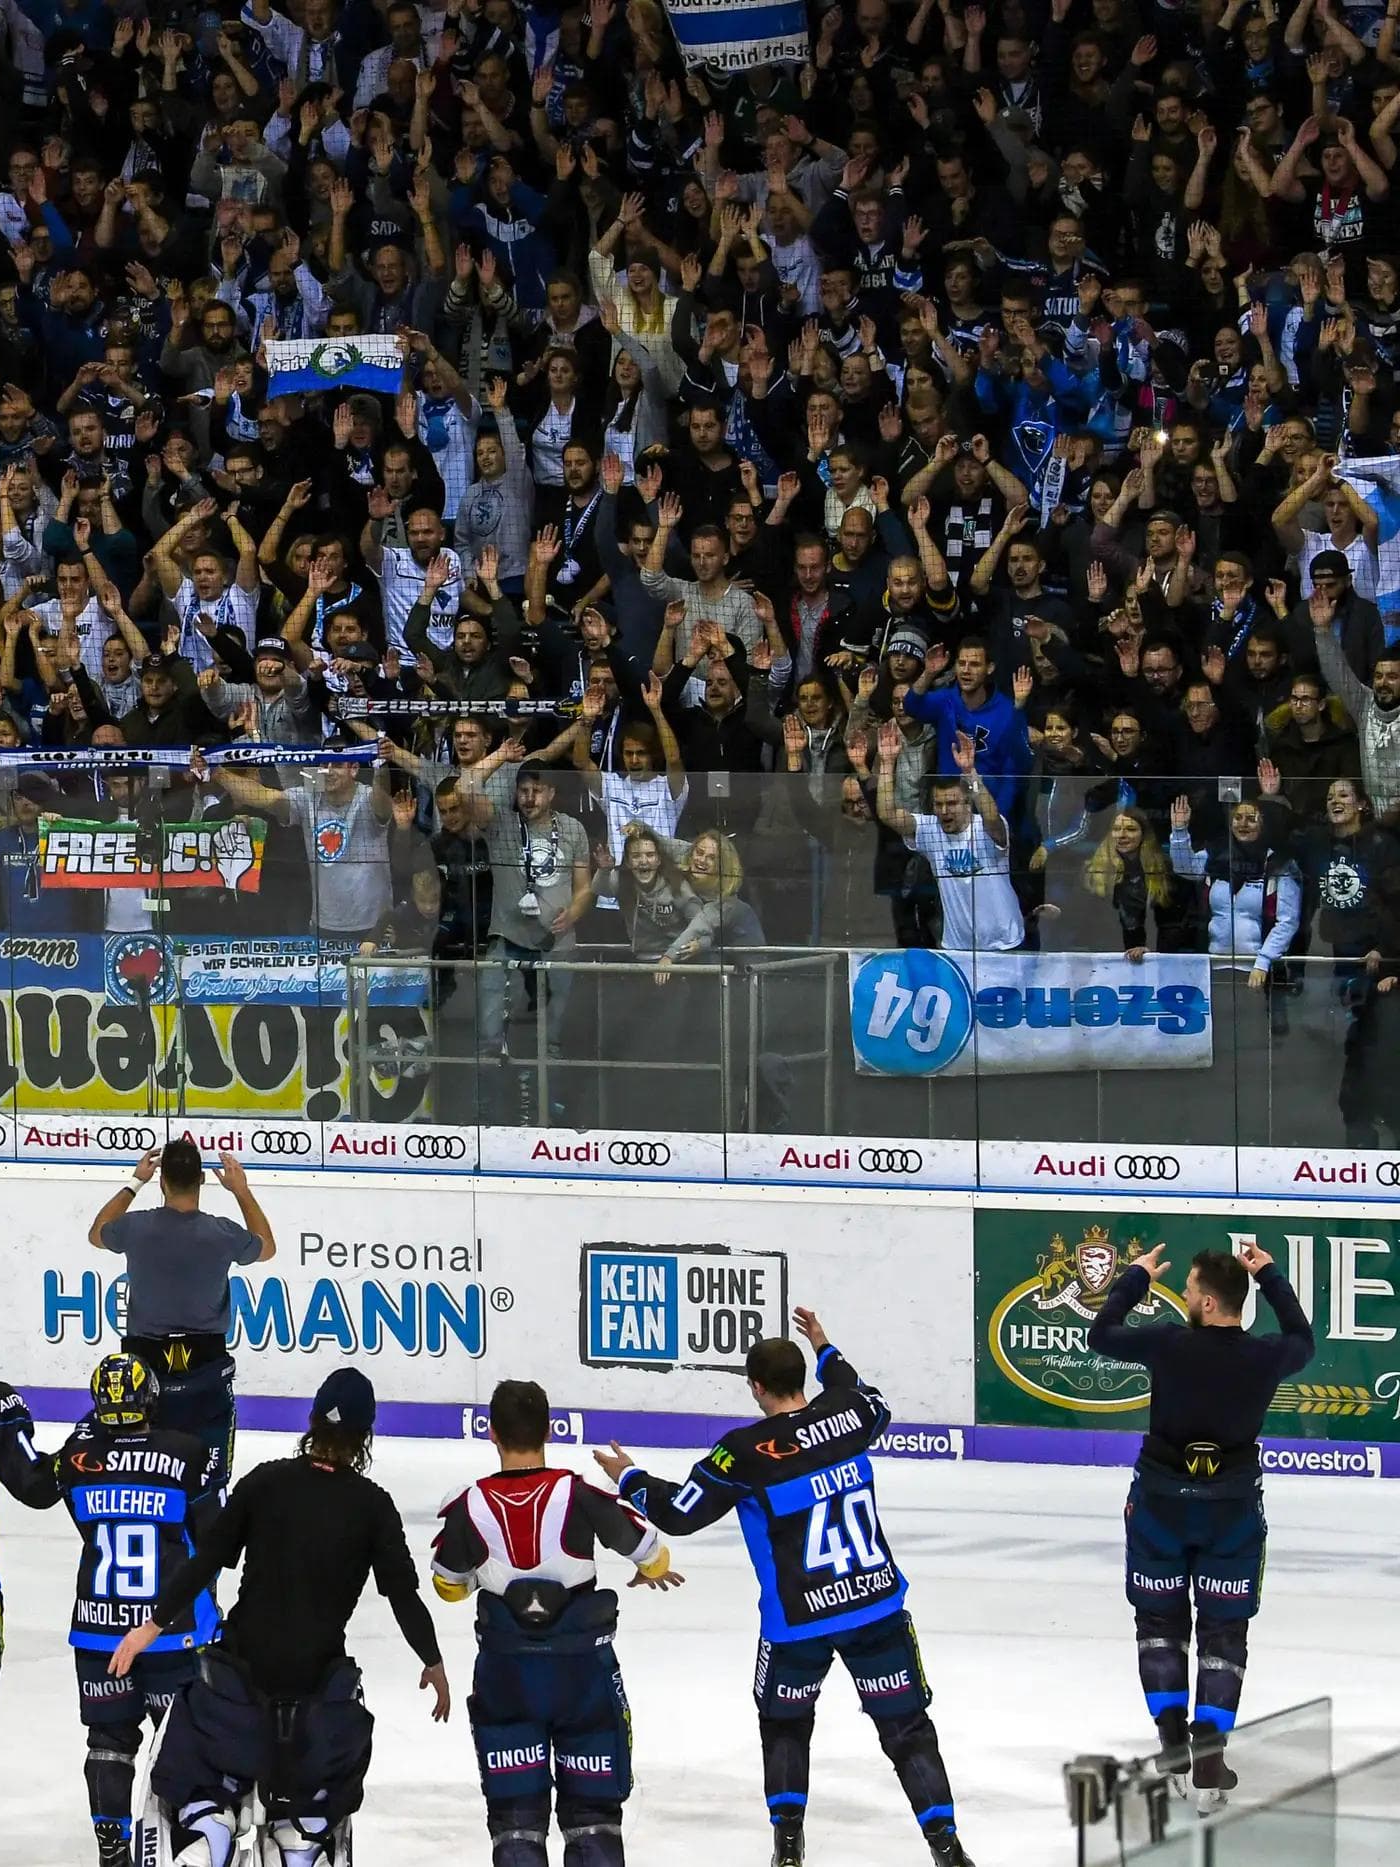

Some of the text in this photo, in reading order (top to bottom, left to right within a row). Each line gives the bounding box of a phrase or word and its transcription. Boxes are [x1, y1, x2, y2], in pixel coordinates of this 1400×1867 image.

[45, 832, 137, 873] FREE
[976, 984, 1207, 1035] Szene
[26, 1128, 88, 1146] Audi
[331, 1135, 395, 1154] Audi
[533, 1141, 598, 1160] Audi
[782, 1148, 849, 1168] Audi
[1035, 1155, 1104, 1175] Audi
[1295, 1162, 1366, 1182] Audi
[300, 1232, 484, 1273] Personal
[599, 1264, 667, 1305] KEIN
[686, 1266, 766, 1306] OHNE
[599, 1307, 666, 1352] FAN
[687, 1309, 764, 1354] JOB
[796, 1409, 862, 1450] SATURN
[105, 1450, 186, 1482] SATURN
[1263, 1451, 1365, 1472] covestro
[810, 1461, 862, 1500] OLVER
[86, 1490, 167, 1518] KELLEHER
[803, 1487, 887, 1577] 40
[91, 1522, 160, 1600] 19
[1133, 1571, 1185, 1592] CINQUE
[1197, 1574, 1251, 1596] CINQUE
[77, 1599, 159, 1628] INGOLSTA
[82, 1678, 134, 1698] CINQUE
[854, 1668, 910, 1694] CINQUE
[486, 1743, 547, 1769] CINQUE
